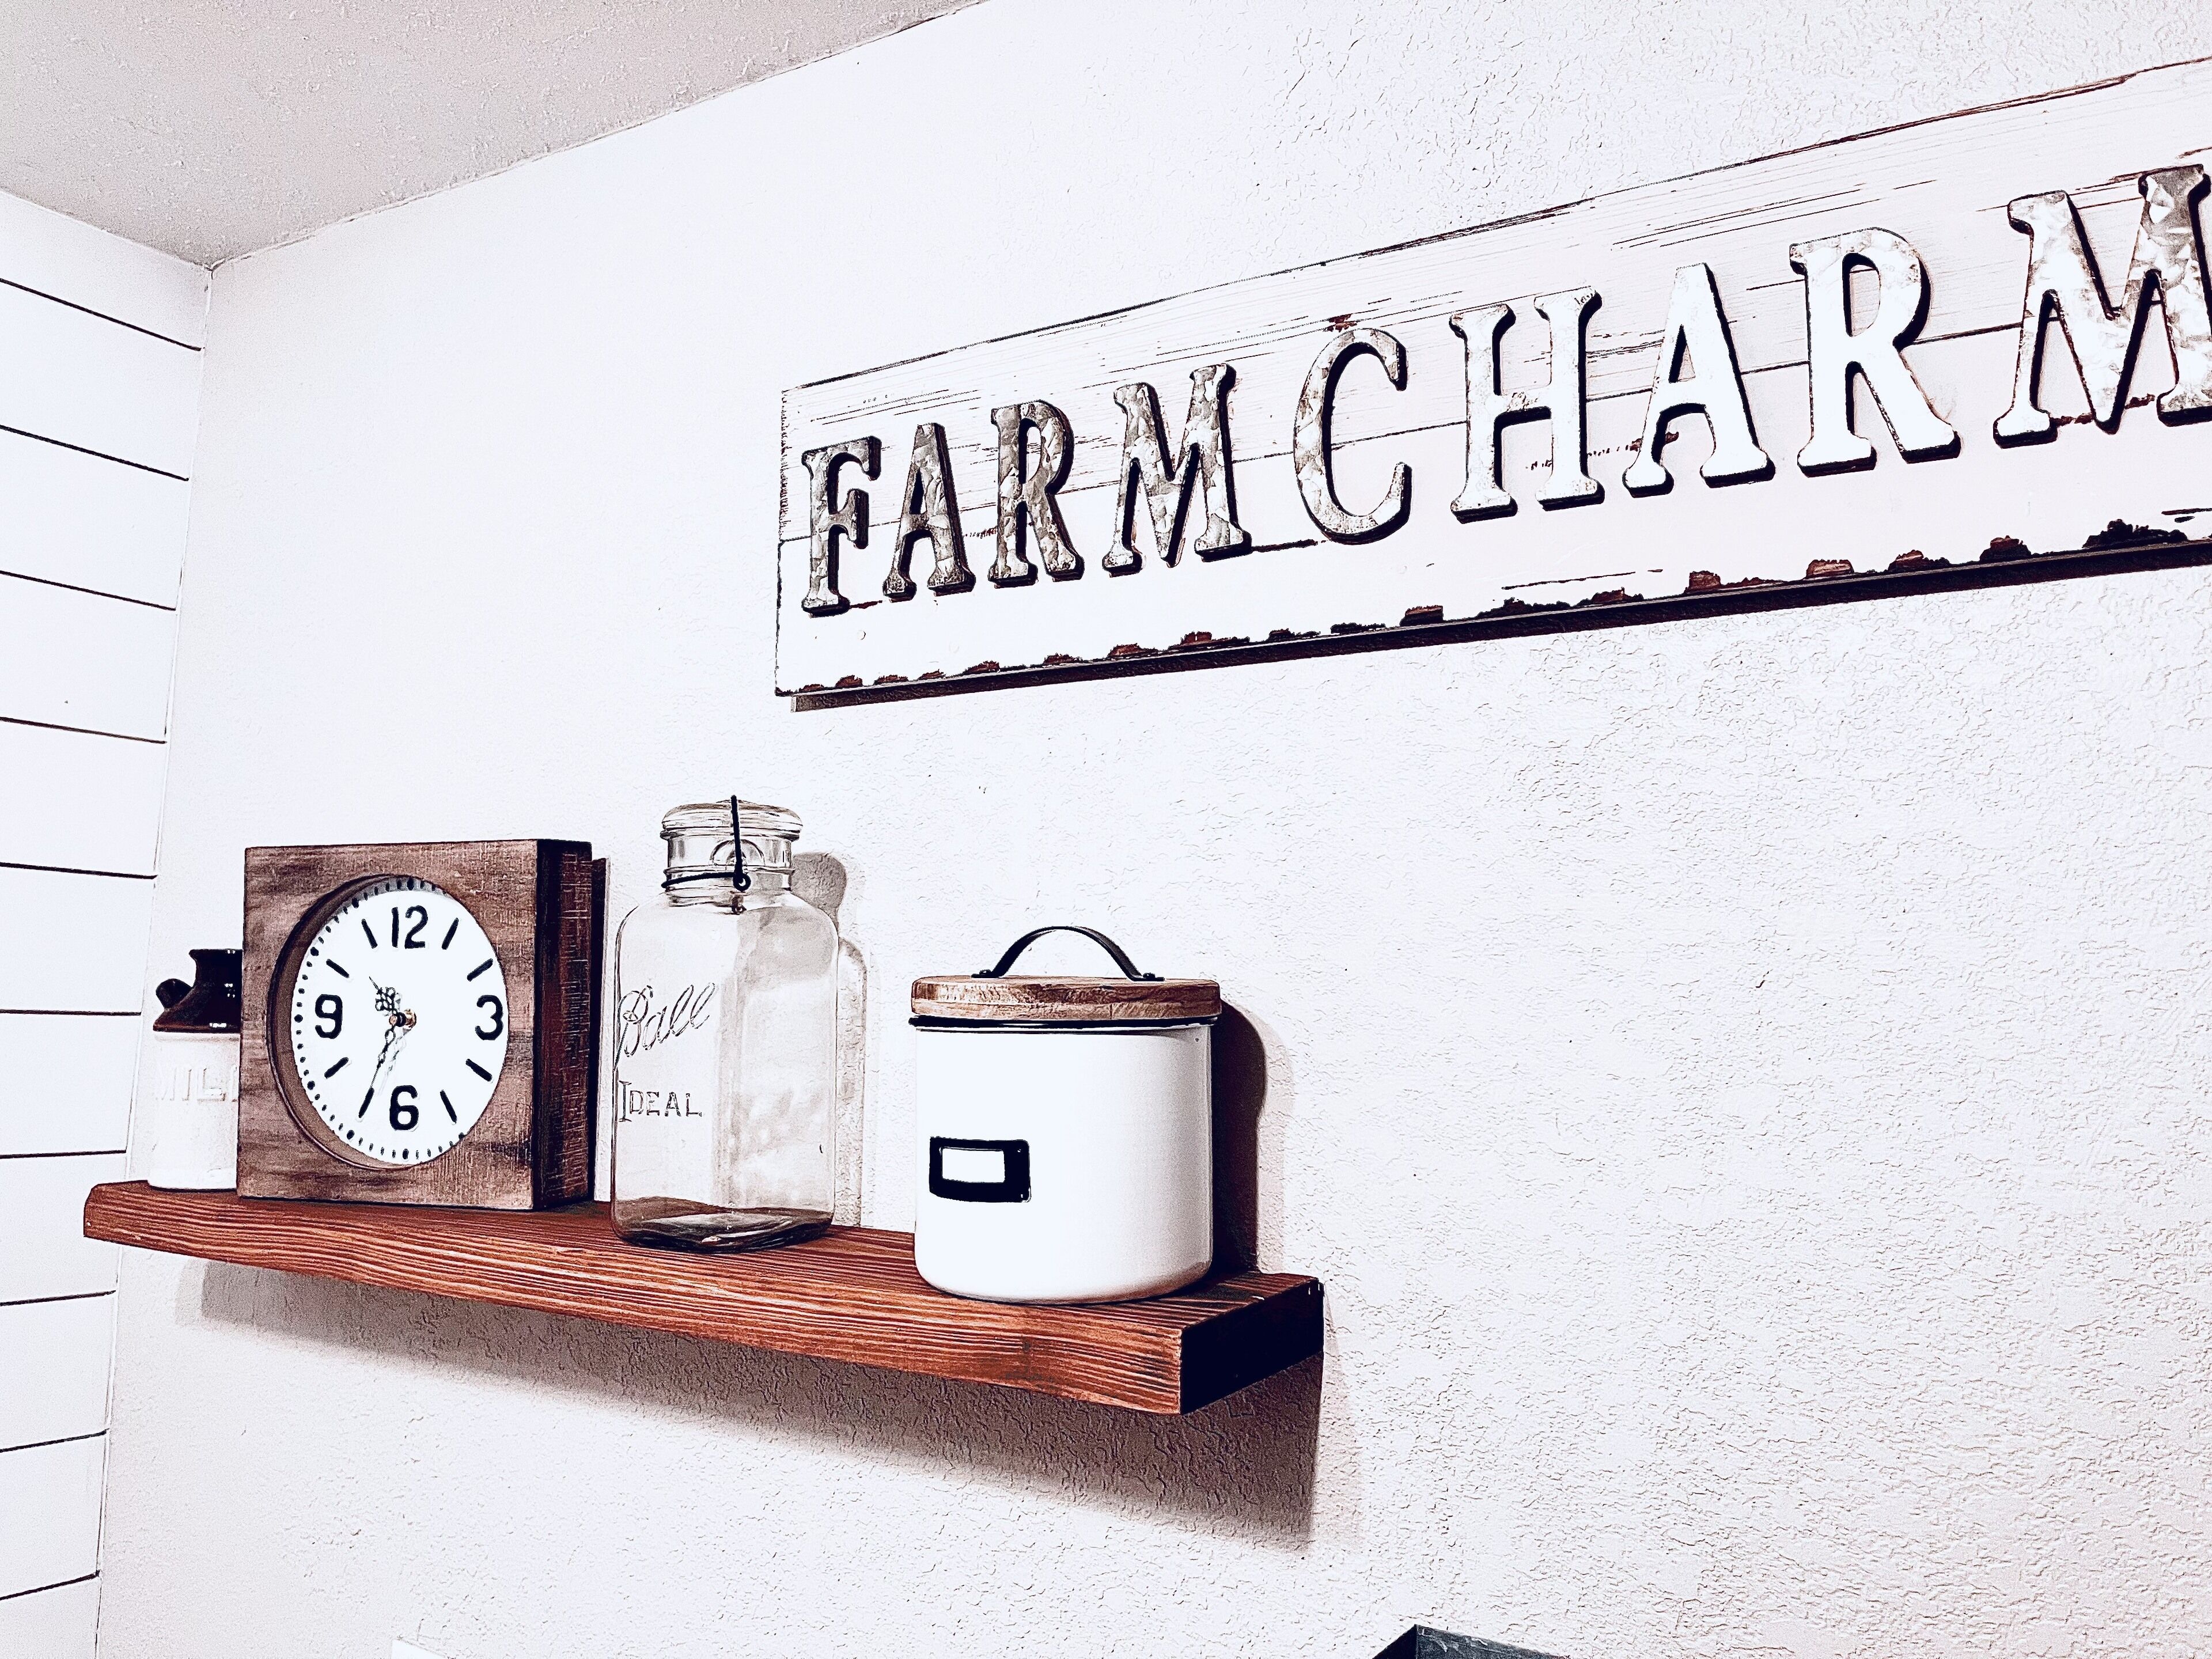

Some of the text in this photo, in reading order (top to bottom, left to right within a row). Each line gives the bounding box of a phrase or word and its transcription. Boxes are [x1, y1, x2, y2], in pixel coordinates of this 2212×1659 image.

[801, 164, 2212, 616] FARM CHARM
[391, 906, 429, 949] 12
[315, 994, 343, 1039] 9
[475, 995, 503, 1040] 3
[613, 983, 717, 1073] Ball
[156, 1066, 238, 1103] MIL
[618, 1081, 702, 1123] IDEAL
[389, 1085, 419, 1131] 6
